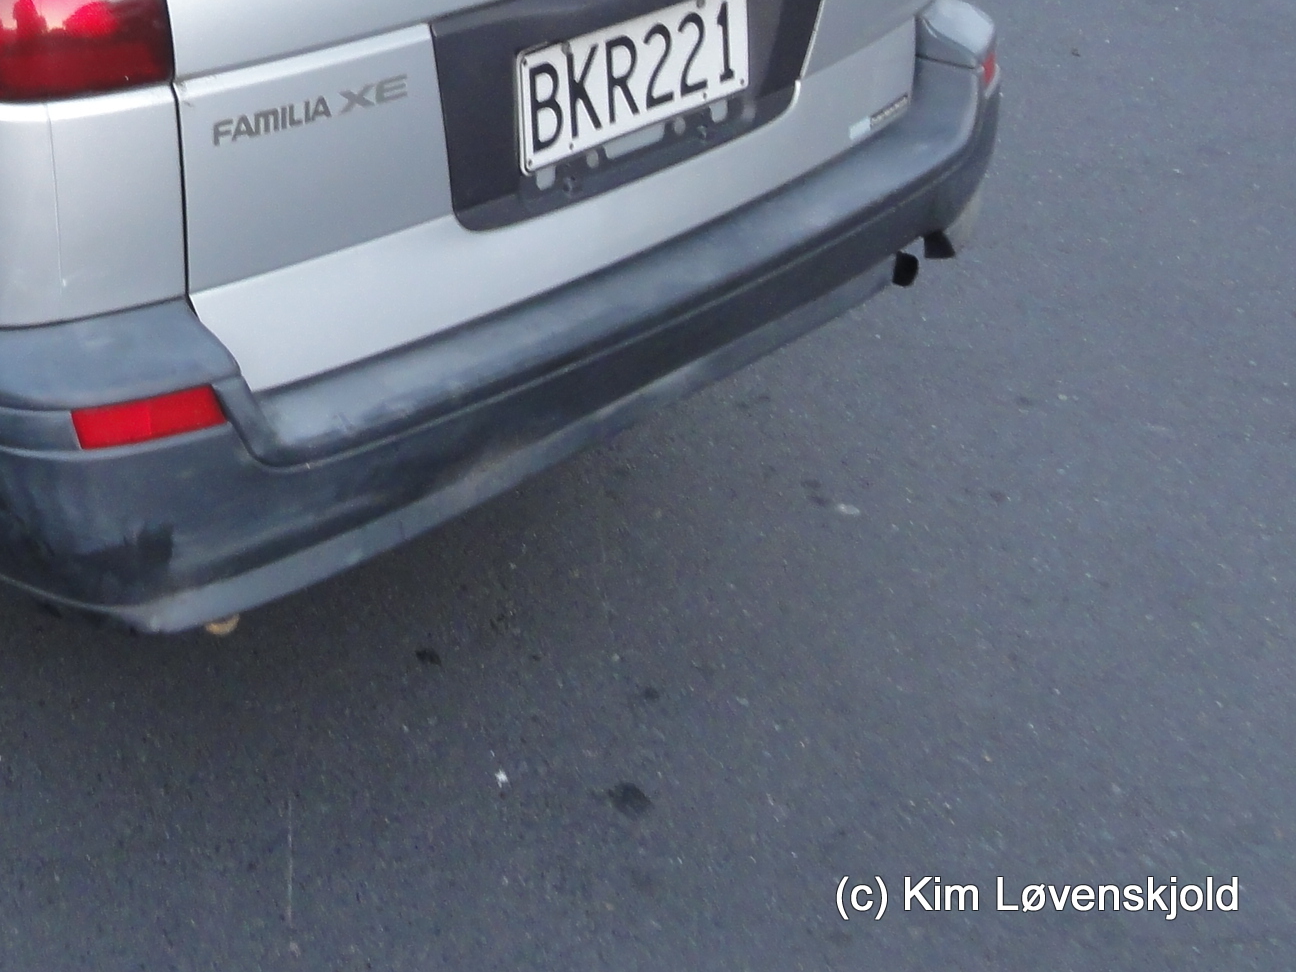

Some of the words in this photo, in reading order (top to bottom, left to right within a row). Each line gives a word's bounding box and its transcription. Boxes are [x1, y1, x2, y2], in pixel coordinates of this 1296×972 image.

[212, 94, 333, 147] FAMILIA
[338, 73, 408, 116] XE
[529, 0, 735, 155] BKR221
